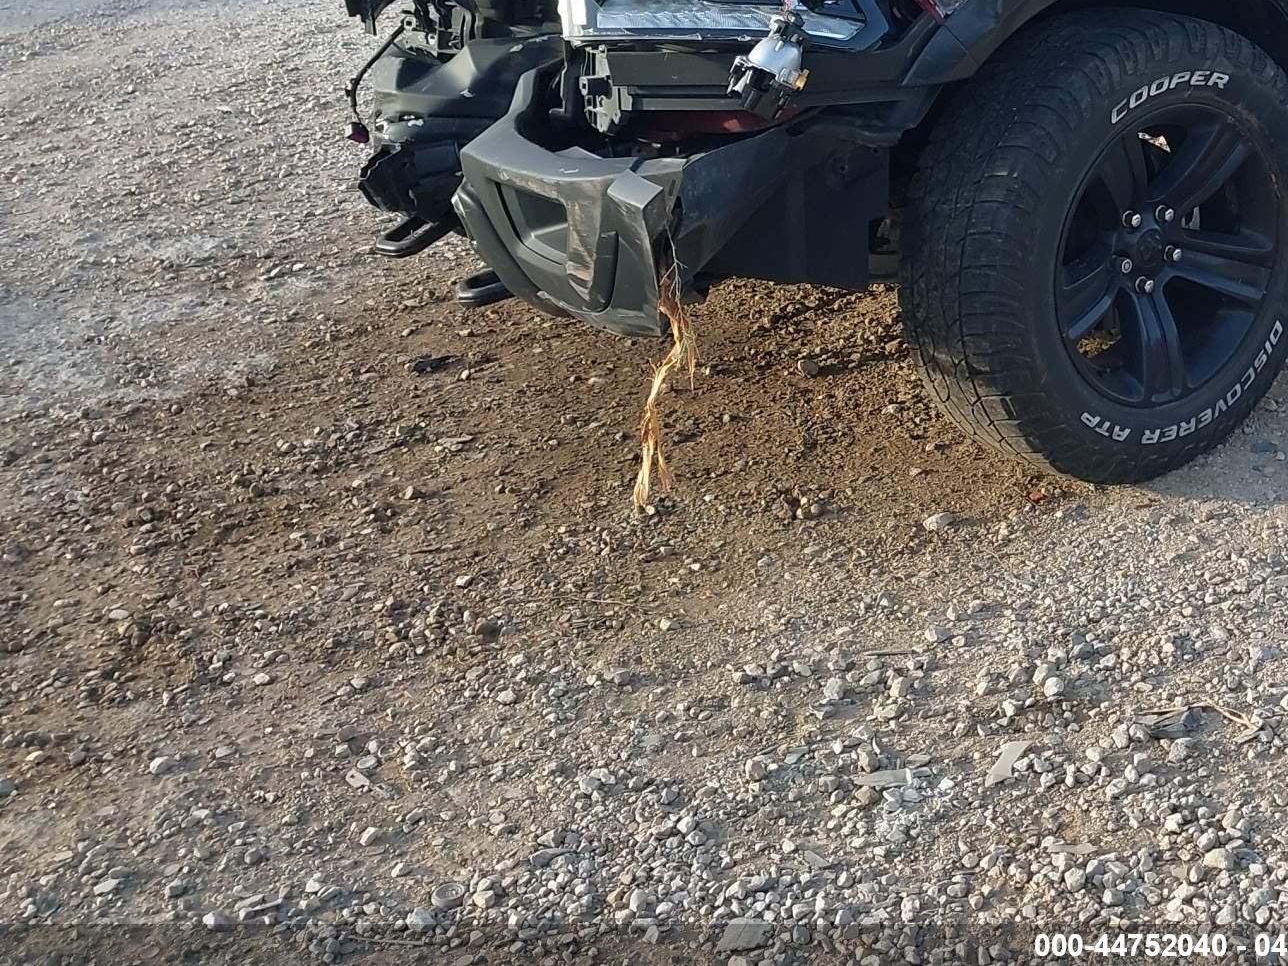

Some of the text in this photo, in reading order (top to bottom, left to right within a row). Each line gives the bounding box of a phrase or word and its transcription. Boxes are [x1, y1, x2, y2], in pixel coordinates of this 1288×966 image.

[1111, 70, 1230, 124] COOPER
[1080, 320, 1284, 445] DISCOVERER ATP
